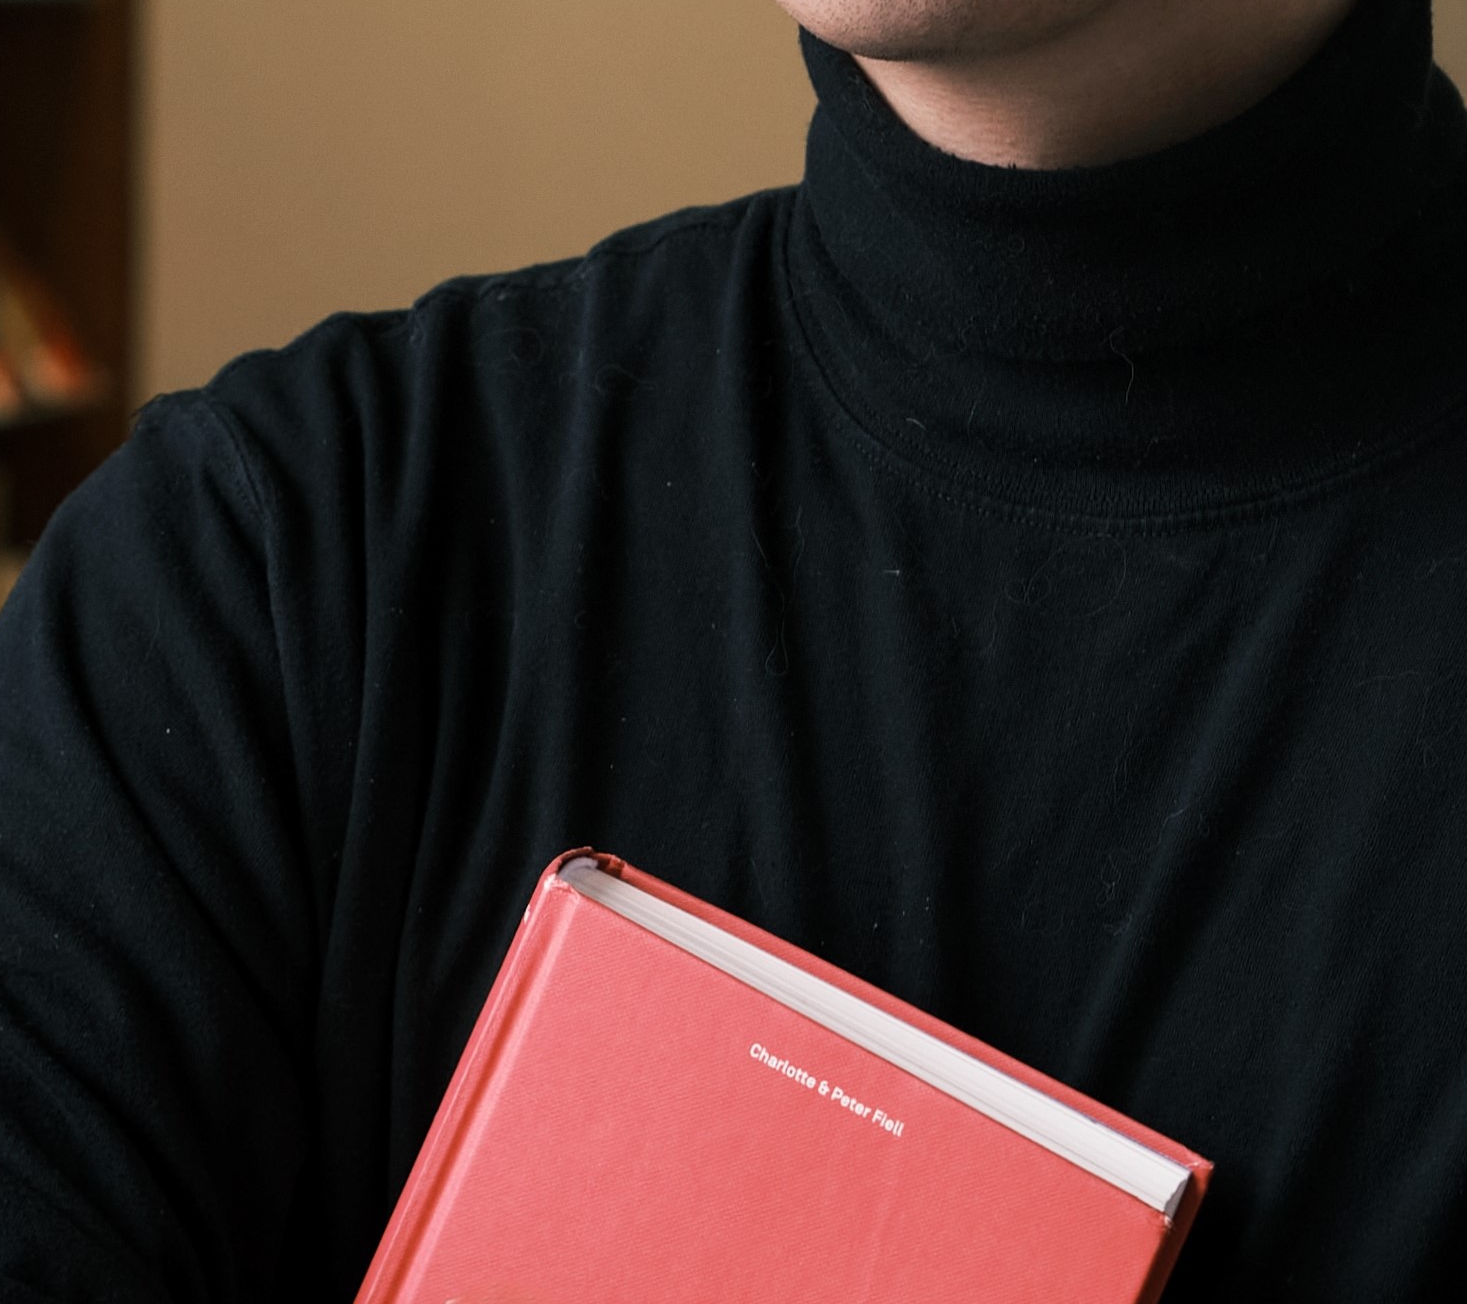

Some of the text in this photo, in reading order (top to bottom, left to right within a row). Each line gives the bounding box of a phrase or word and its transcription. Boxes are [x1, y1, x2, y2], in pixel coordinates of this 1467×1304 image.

[749, 1042, 817, 1089] Charlotte
[818, 1080, 830, 1096] &
[831, 1087, 871, 1118] Peter
